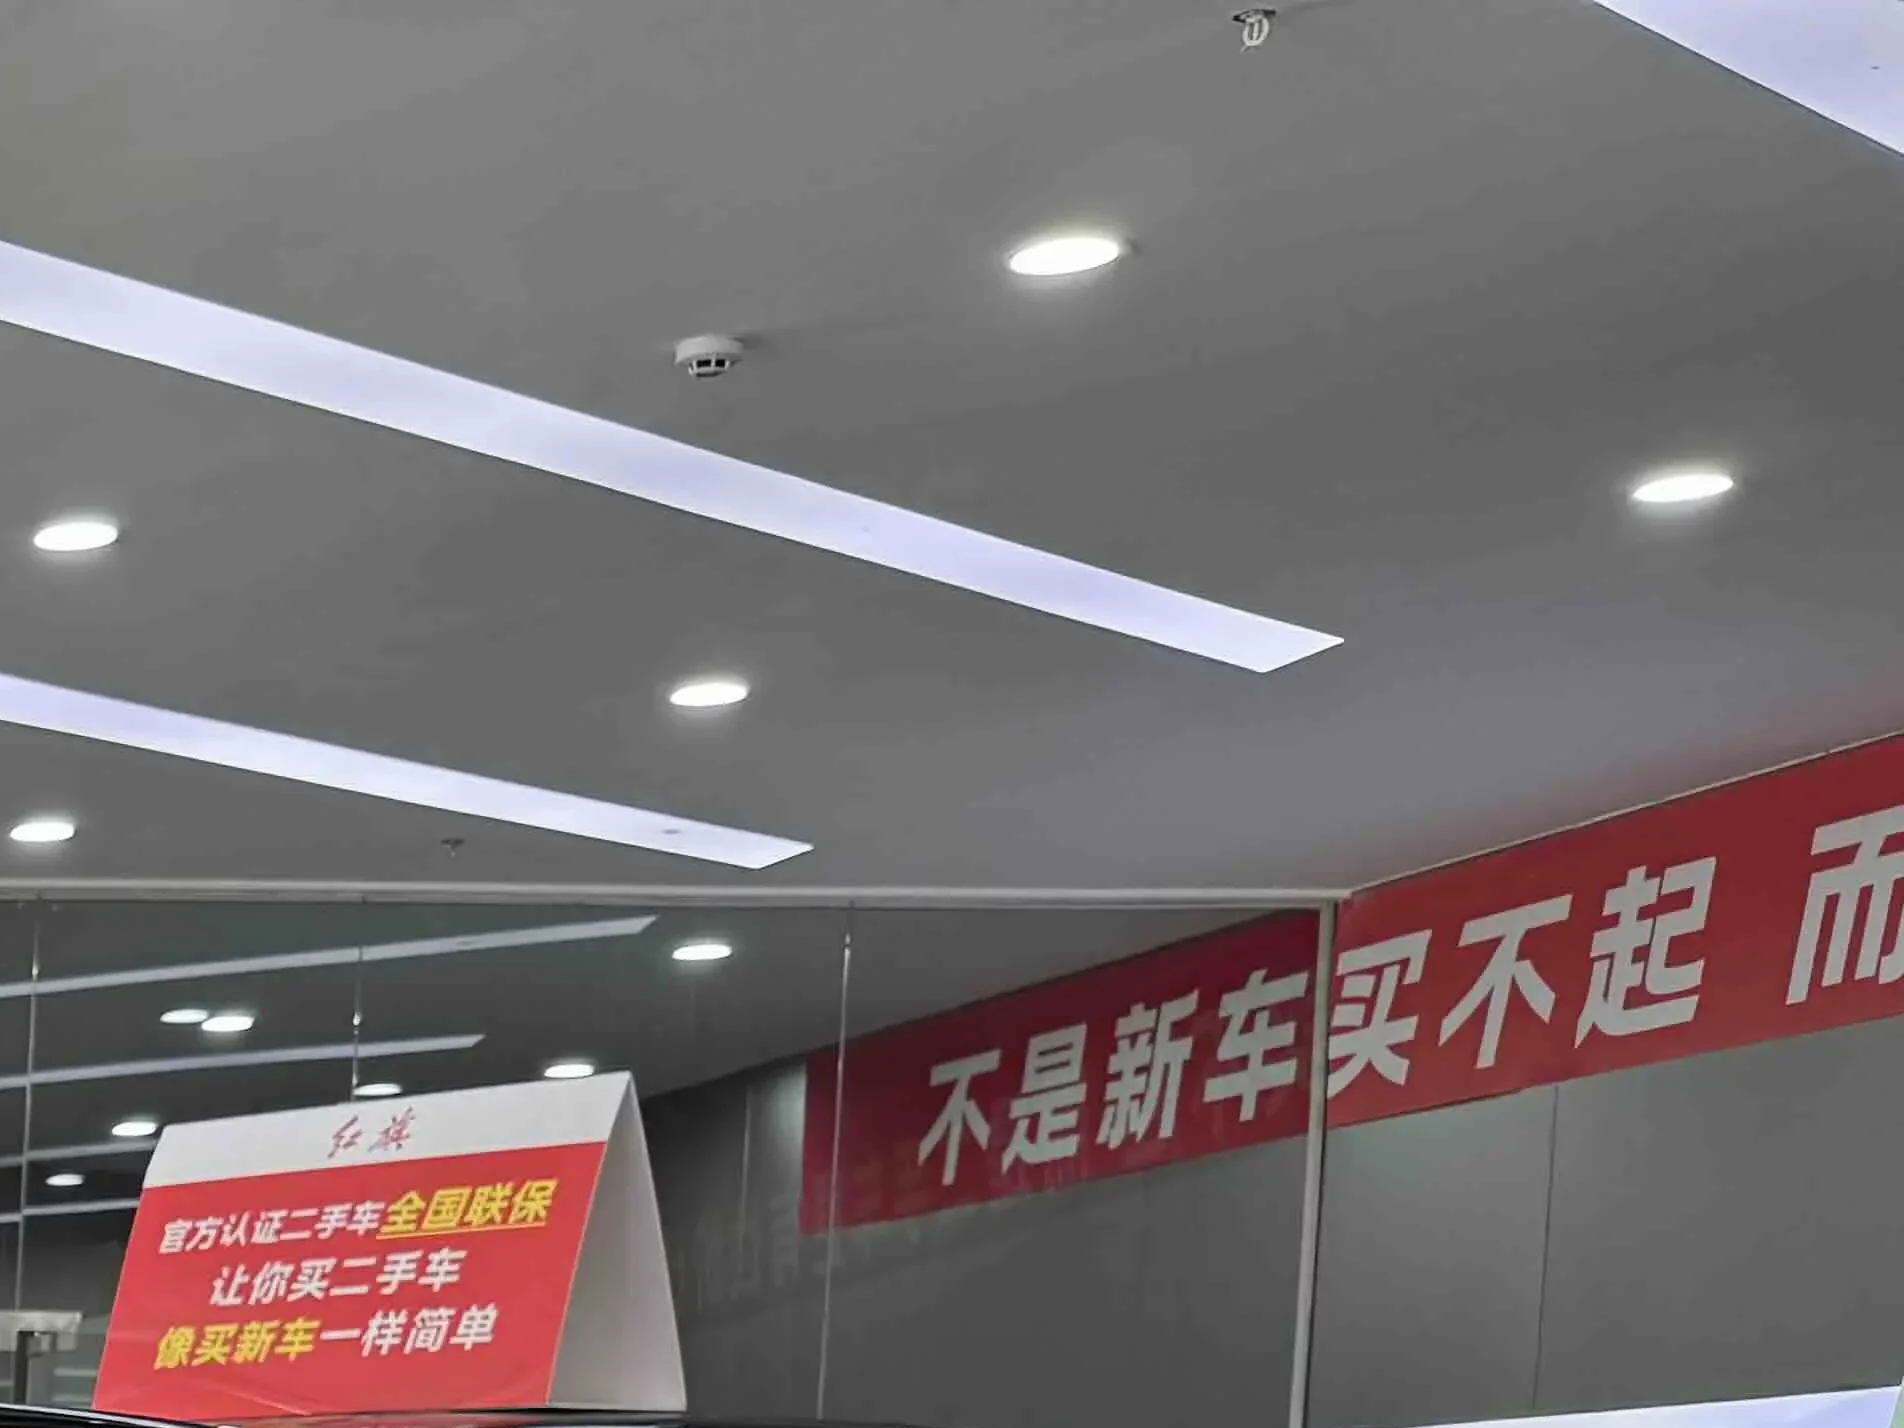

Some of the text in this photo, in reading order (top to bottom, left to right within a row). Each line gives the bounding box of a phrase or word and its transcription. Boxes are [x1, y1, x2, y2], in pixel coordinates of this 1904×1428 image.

[917, 856, 1718, 1188] 不是新车买不起
[158, 1179, 559, 1254] 官方认证二手车全国联保
[209, 1247, 468, 1306] 让你买二手车
[153, 1303, 498, 1371] 像买新车一样简单
